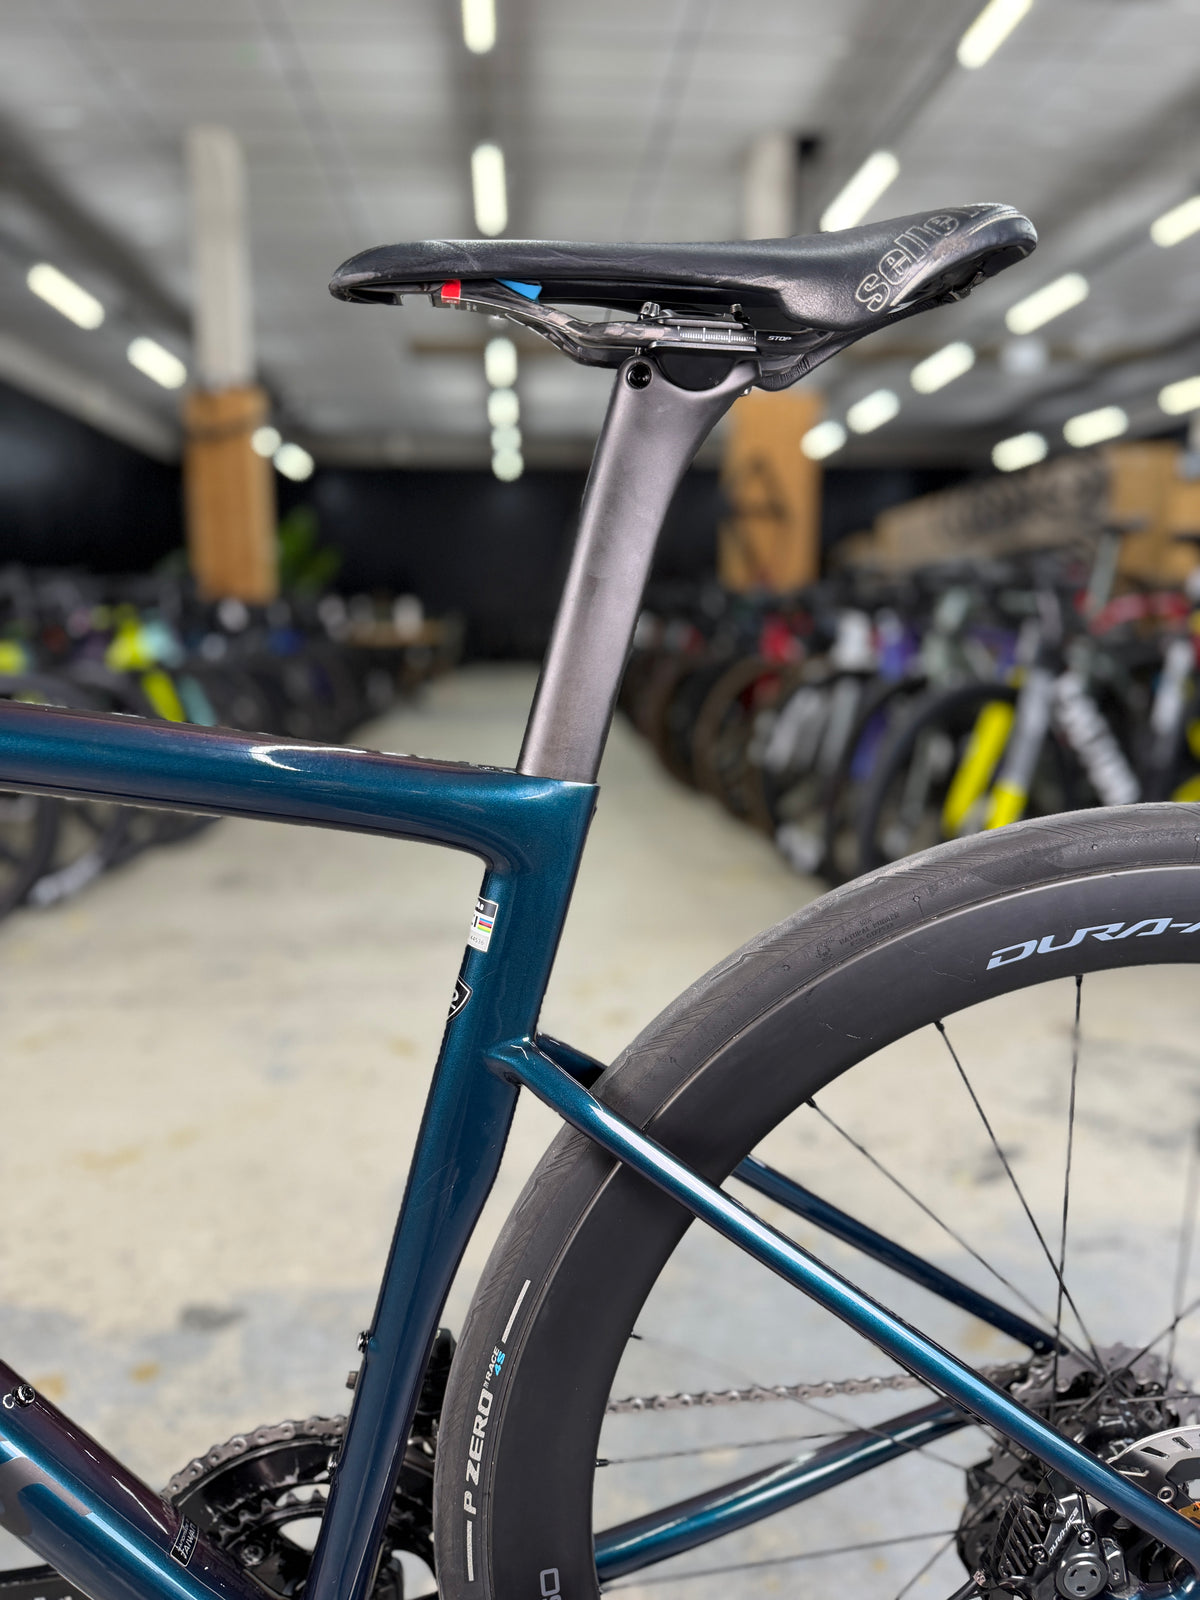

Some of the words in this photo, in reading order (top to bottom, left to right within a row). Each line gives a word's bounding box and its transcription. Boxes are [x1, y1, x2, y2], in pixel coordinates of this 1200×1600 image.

[855, 214, 960, 313] selle
[463, 1490, 477, 1515] P
[486, 1345, 500, 1382] RACE
[494, 1351, 506, 1377] 4S
